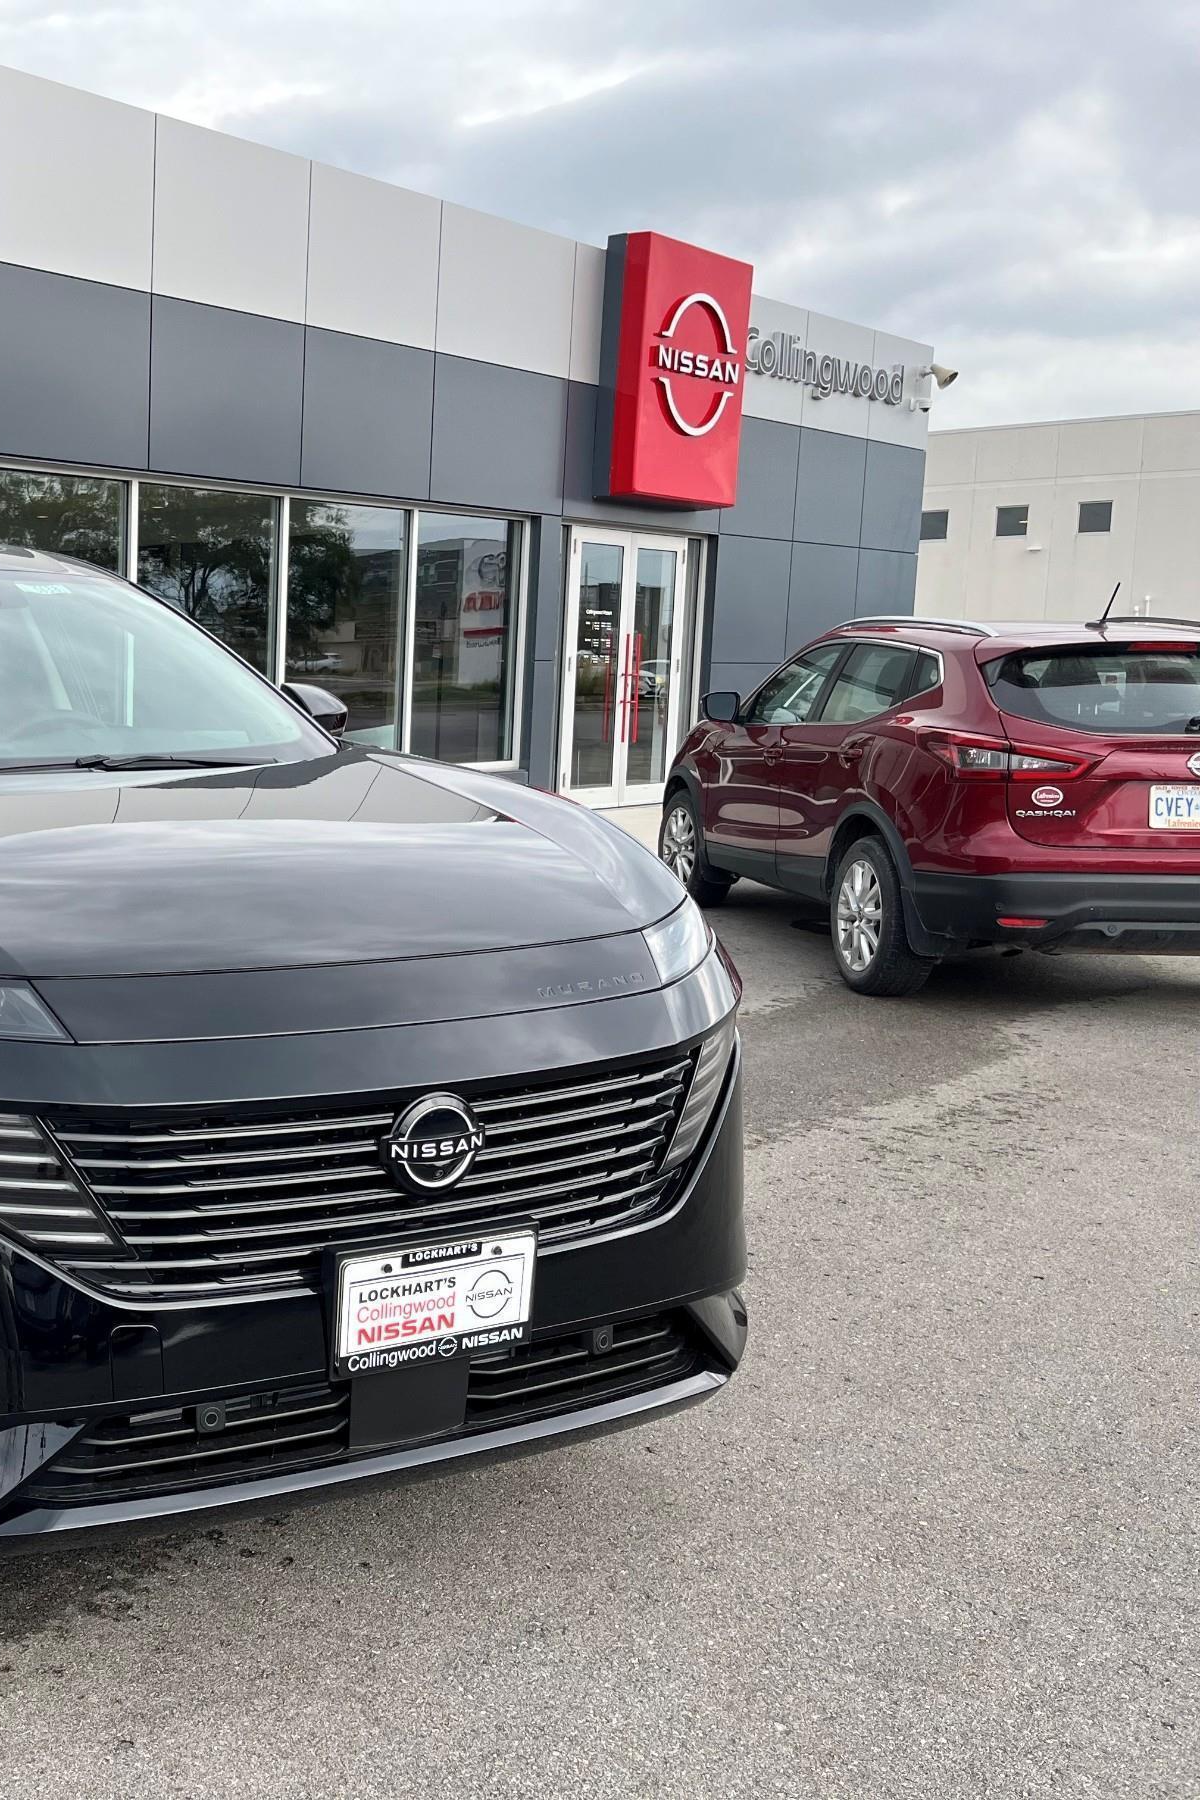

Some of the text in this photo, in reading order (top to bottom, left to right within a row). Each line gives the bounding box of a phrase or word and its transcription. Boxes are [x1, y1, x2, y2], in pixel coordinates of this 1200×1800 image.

[657, 344, 740, 385] NISSAN
[744, 326, 905, 405] Collingwood
[1015, 809, 1076, 818] QASHQAI
[1154, 796, 1194, 817] CVEY
[537, 972, 645, 999] MURANO
[390, 1132, 483, 1159] NISSAN
[409, 1243, 478, 1263] LOCKHART'S
[358, 1276, 457, 1304] LOCKHART'S
[465, 1286, 513, 1302] NISSAN
[356, 1291, 456, 1323] Collingwood
[356, 1312, 456, 1346] NISSAN
[347, 1340, 437, 1372] Collingwood
[461, 1326, 523, 1350] NISSAN
